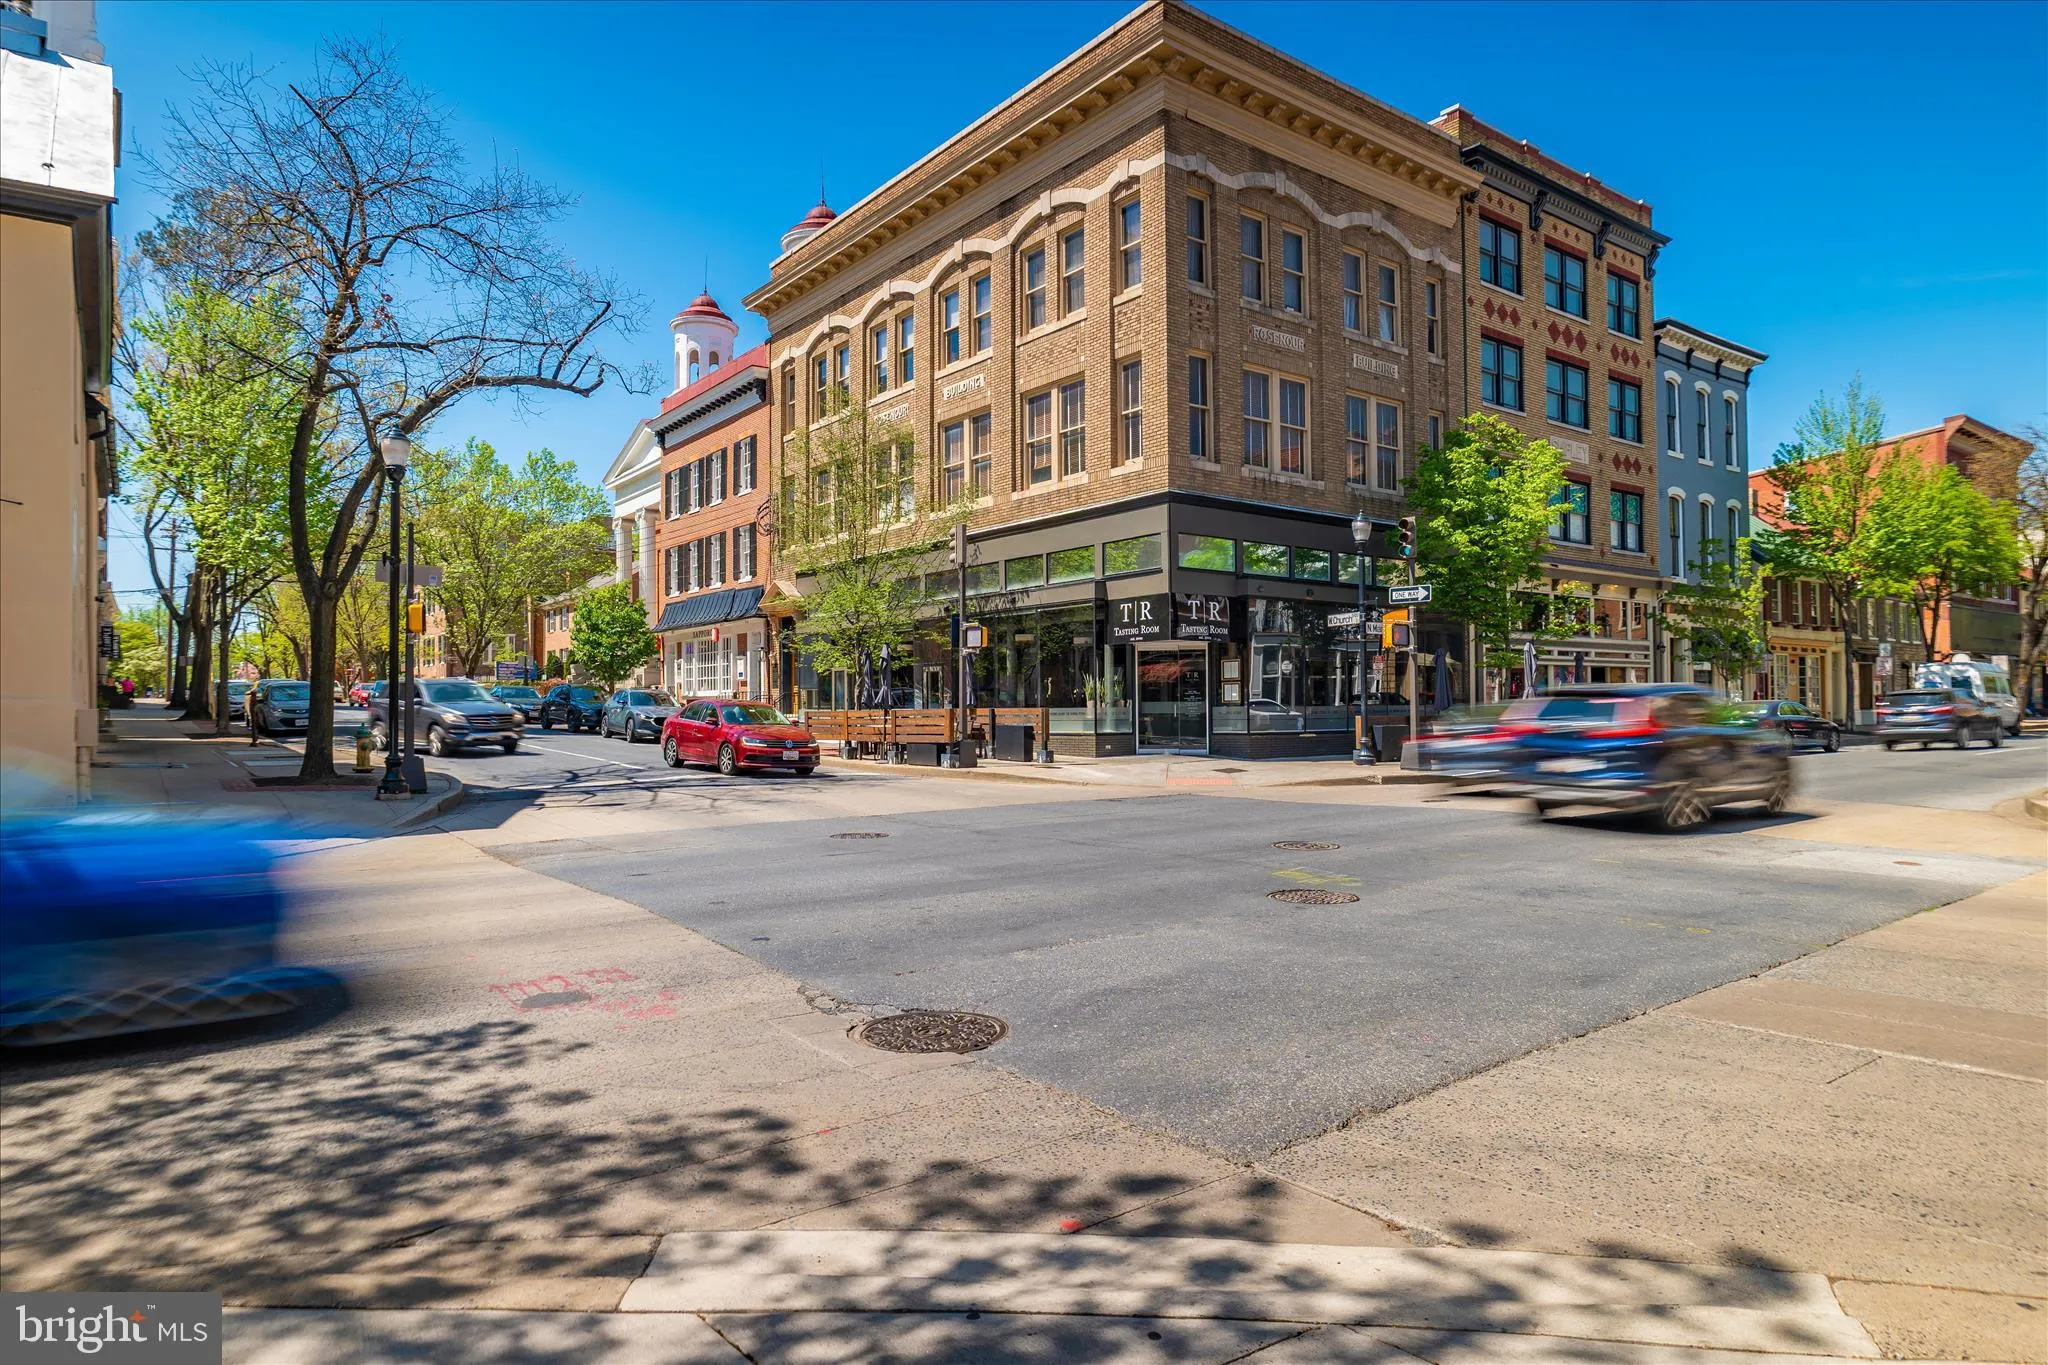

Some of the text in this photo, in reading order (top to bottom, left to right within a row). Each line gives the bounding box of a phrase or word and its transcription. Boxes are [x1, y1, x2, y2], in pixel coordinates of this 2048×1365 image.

[1252, 326, 1304, 351] ROSENOUR
[1356, 356, 1397, 377] BUILDING
[945, 375, 981, 398] BUILDING
[1333, 614, 1353, 625] Church
